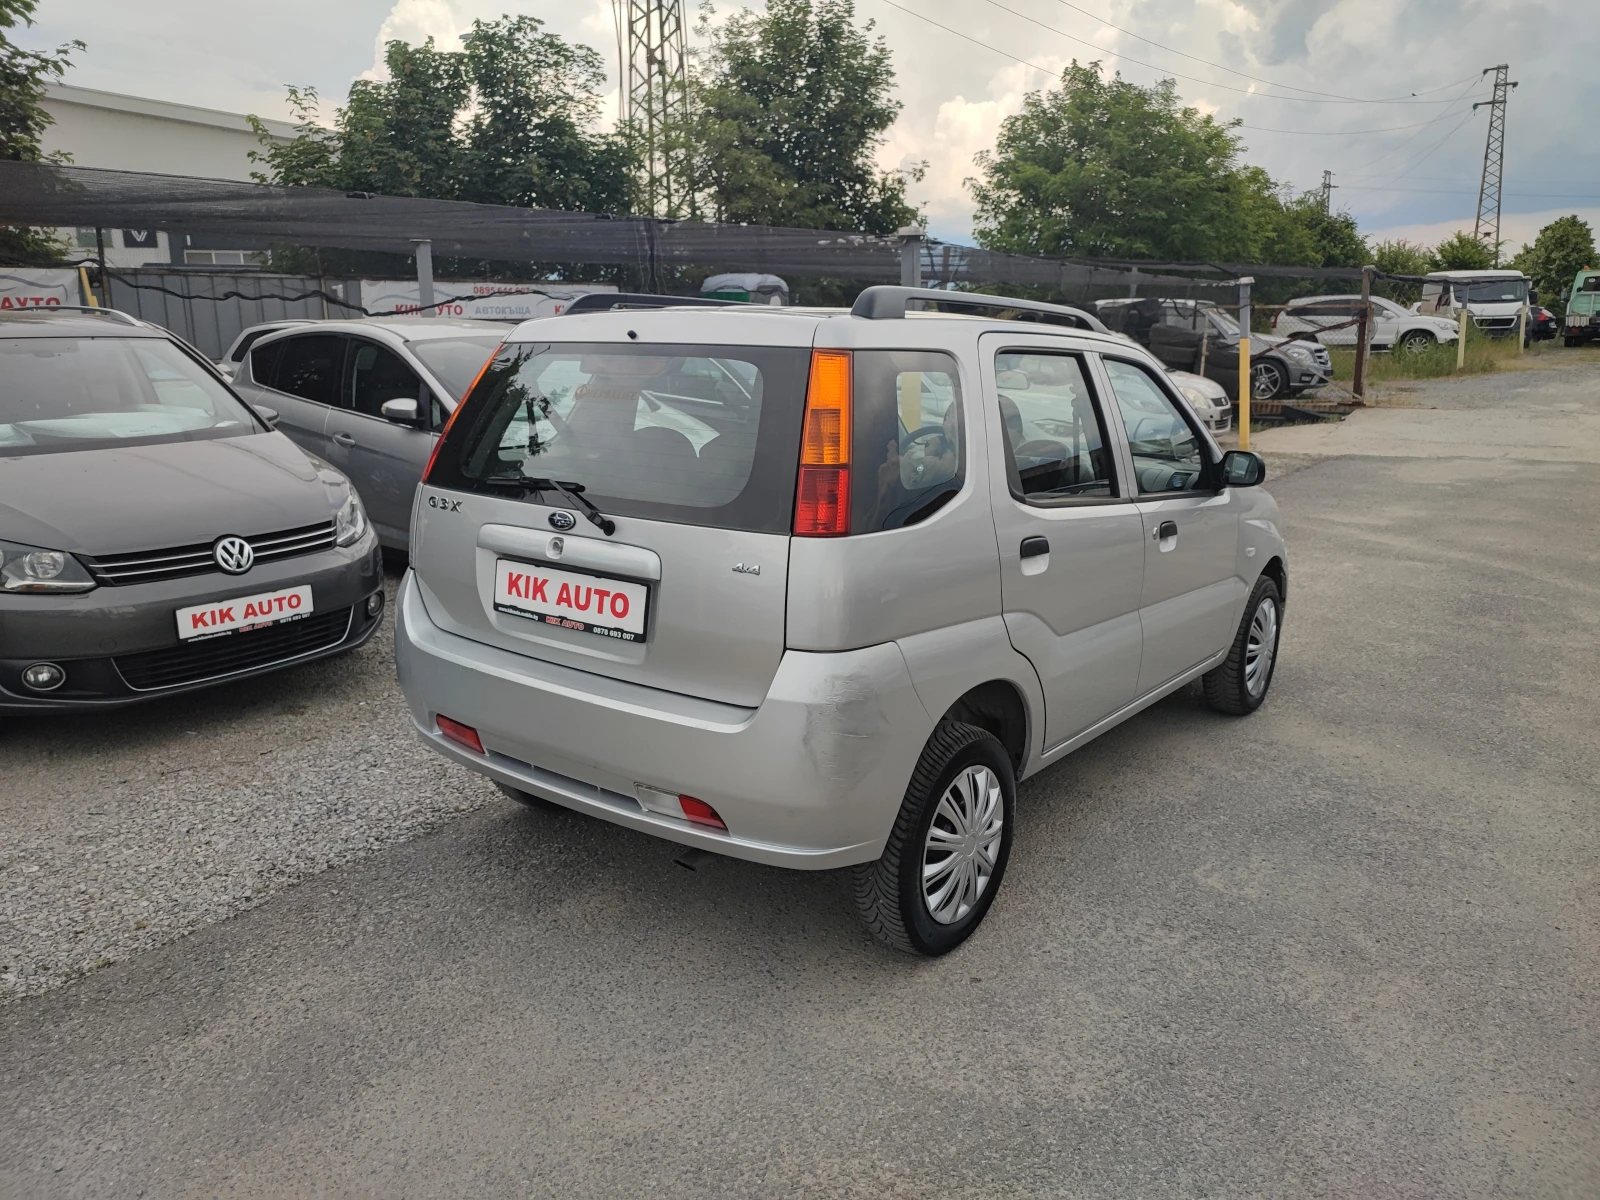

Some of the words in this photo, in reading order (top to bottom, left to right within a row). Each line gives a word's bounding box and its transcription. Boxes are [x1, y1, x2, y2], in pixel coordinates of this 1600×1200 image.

[473, 286, 496, 295] 0895
[434, 304, 463, 316] УТО
[475, 306, 531, 315] АВТОКЪЩА
[429, 495, 463, 513] G3X
[507, 572, 549, 603] KIK
[555, 582, 630, 618] AUTO
[191, 607, 235, 629] KIK
[243, 594, 301, 619] AUTO
[545, 616, 560, 626] KIK
[562, 620, 584, 630] AUTO
[622, 632, 635, 641] 007
